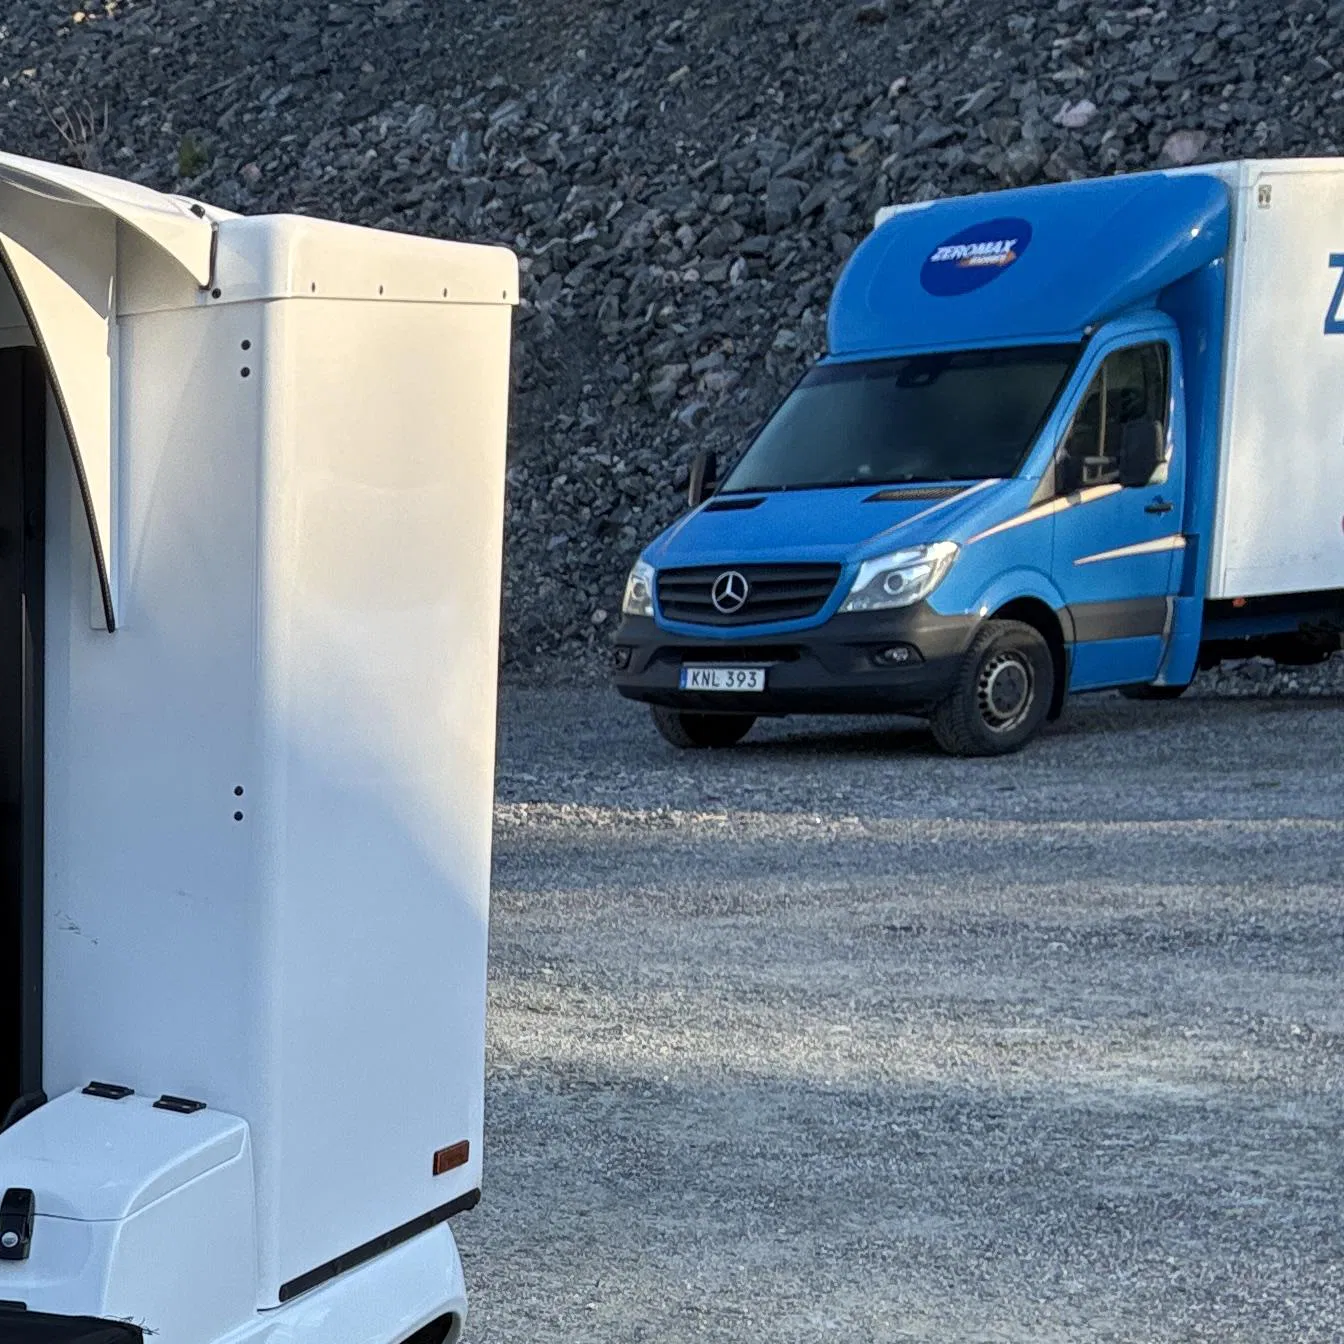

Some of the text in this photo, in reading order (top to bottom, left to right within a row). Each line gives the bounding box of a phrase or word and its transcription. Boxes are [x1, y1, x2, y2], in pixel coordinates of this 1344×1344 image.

[930, 239, 1018, 262] ZEROMAX
[692, 671, 757, 687] KNL 393
